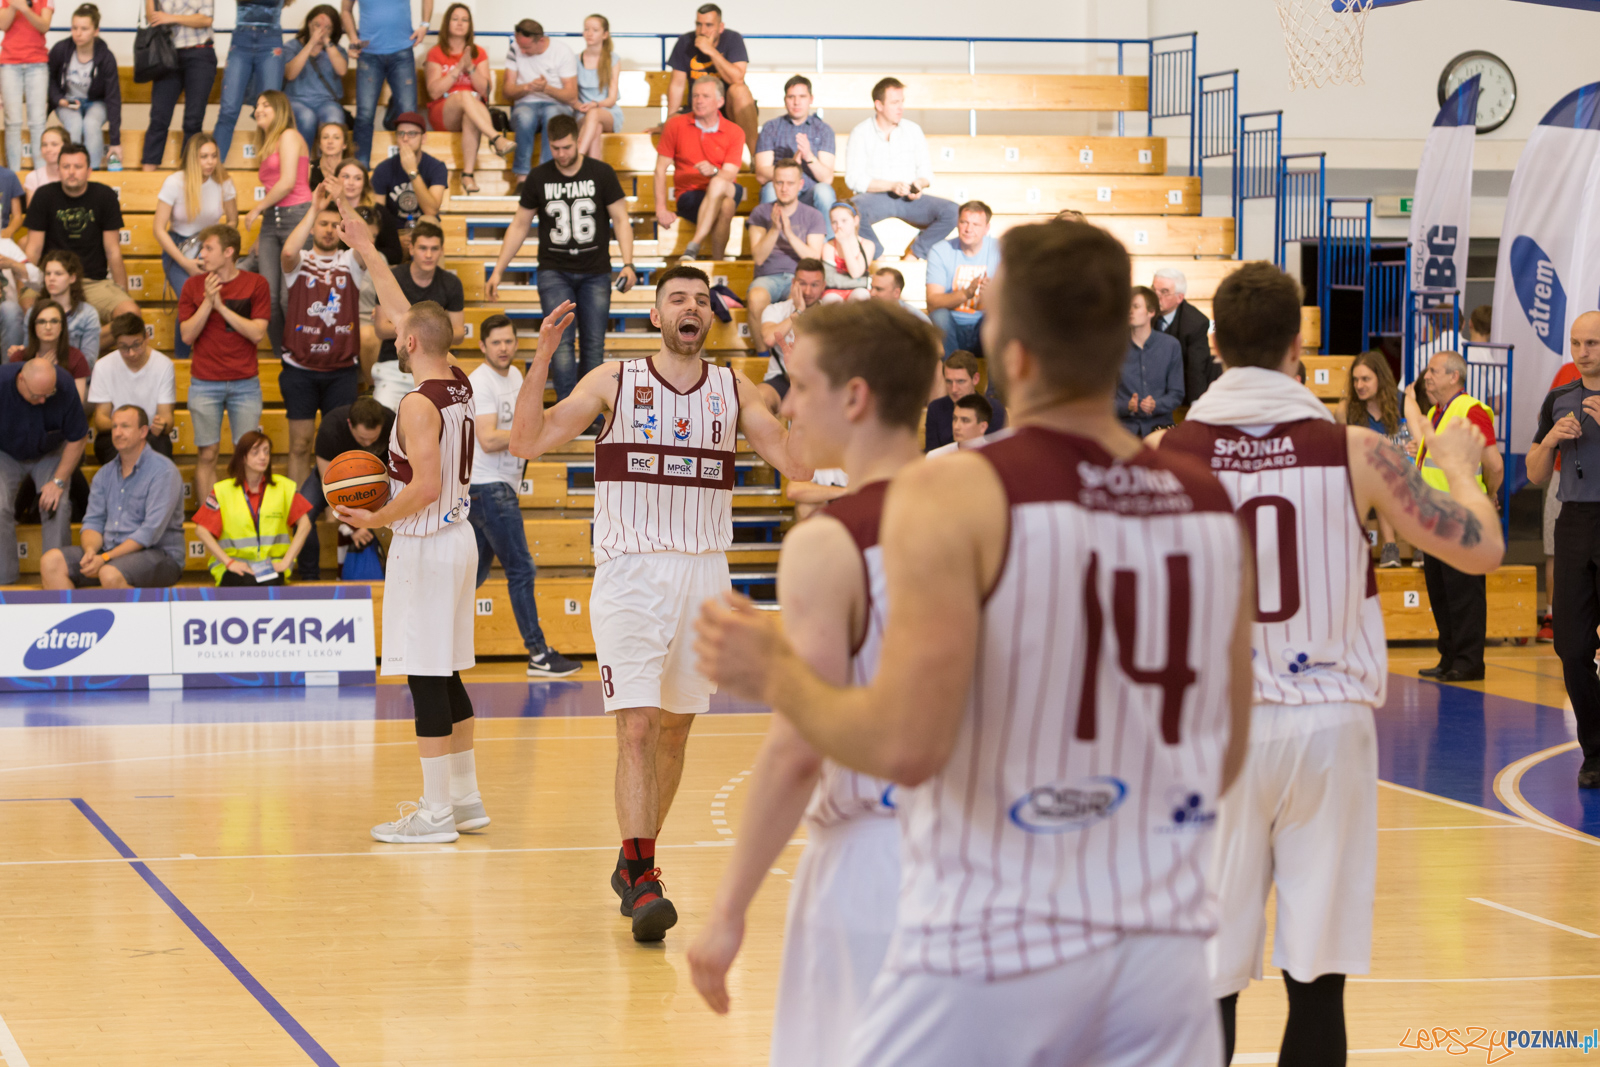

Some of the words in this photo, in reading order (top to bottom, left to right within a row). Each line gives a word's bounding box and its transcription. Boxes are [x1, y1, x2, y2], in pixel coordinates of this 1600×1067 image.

[544, 180, 596, 200] WU-TANG
[545, 197, 597, 245] 36
[129, 276, 142, 289] 13
[1528, 258, 1556, 338] atrem
[310, 343, 330, 352] ZZO
[712, 420, 722, 445] 8
[459, 415, 475, 486] 0
[1214, 436, 1295, 458] SPÓJNIA
[631, 457, 651, 469] PEC
[667, 463, 692, 473] MPGK
[703, 466, 719, 476] ZZO
[338, 488, 377, 503] molten
[190, 543, 205, 557] 13
[1232, 494, 1302, 624] 0
[478, 601, 492, 613] 10
[36, 628, 98, 650] atrem
[183, 616, 356, 646] BIOFARM
[197, 650, 235, 659] POLSKI
[240, 649, 302, 658] PRODUCENT
[307, 647, 343, 657] LEKÓW
[1074, 550, 1197, 747] 14
[601, 664, 615, 698] 8
